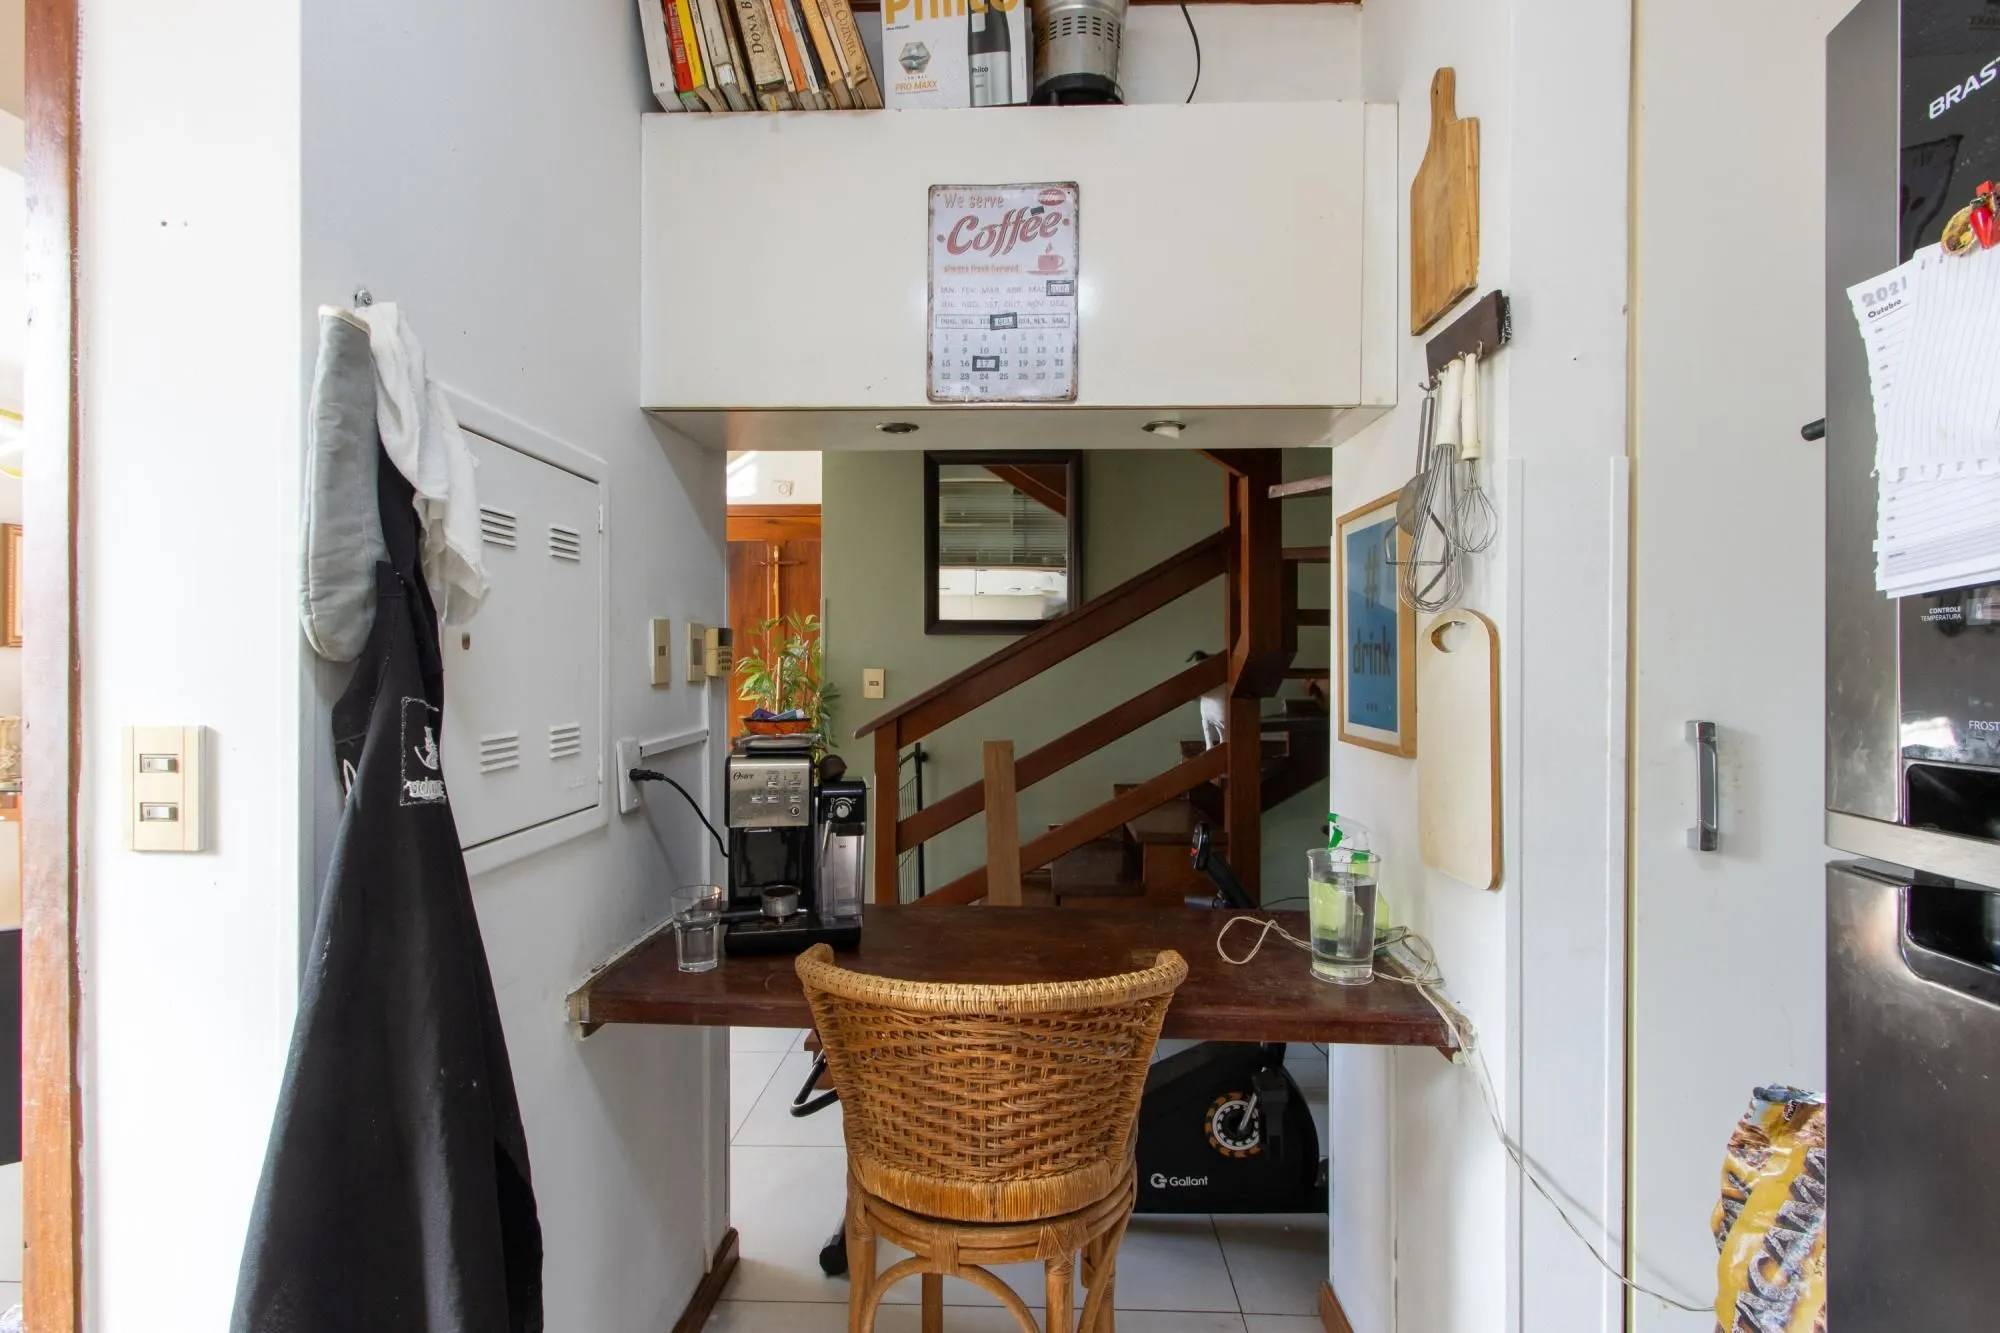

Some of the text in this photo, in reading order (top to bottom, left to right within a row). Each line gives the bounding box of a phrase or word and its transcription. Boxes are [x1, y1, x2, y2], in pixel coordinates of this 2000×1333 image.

[747, 14, 764, 54] DONA
[835, 10, 856, 57] COZINHA
[895, 82, 912, 92] PRO
[914, 79, 938, 90] MAXX
[944, 192, 1005, 209] We serve
[947, 206, 1063, 257] Coffee
[1862, 275, 1907, 308] 2021
[1867, 299, 1902, 319] Outubro
[1920, 614, 1962, 622] TEMPERATURA
[1929, 606, 1962, 615] CONTROLE
[1353, 624, 1391, 676] drink
[1968, 720, 2000, 731] FROST
[1169, 1175, 1208, 1187] Gallant
